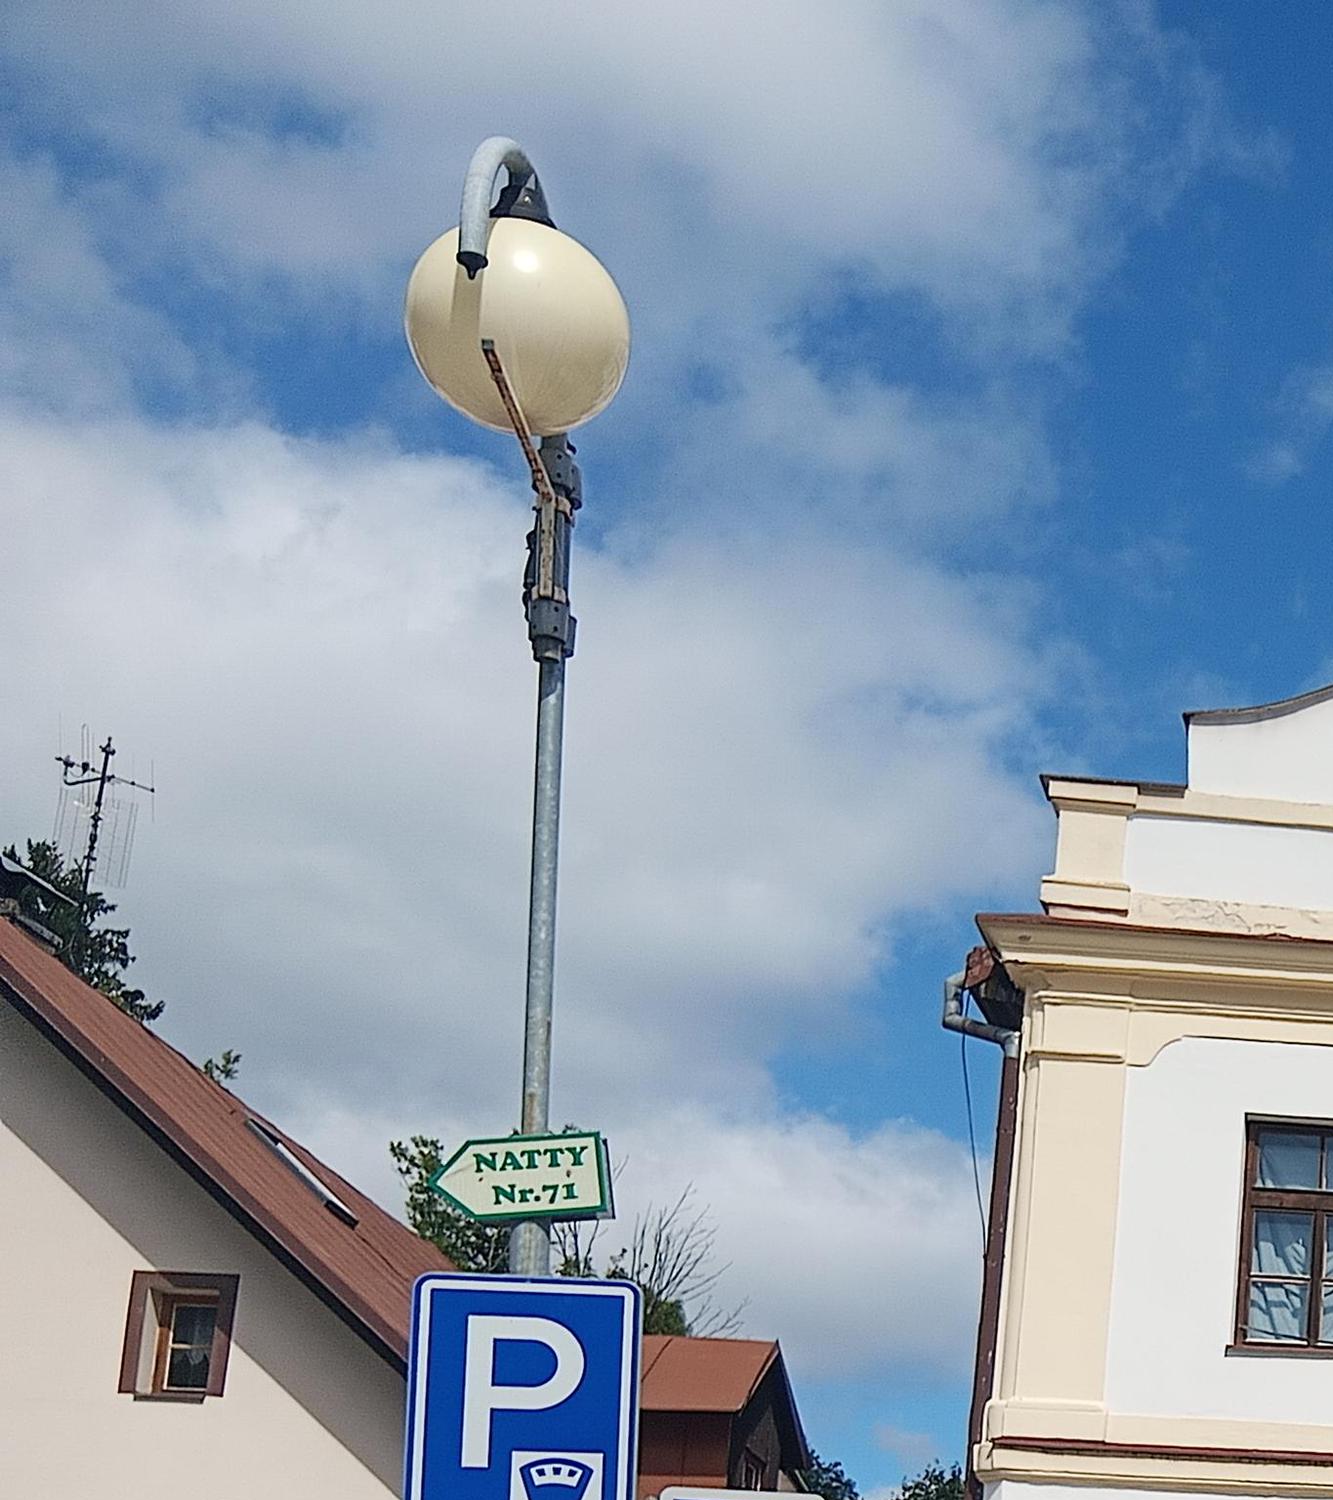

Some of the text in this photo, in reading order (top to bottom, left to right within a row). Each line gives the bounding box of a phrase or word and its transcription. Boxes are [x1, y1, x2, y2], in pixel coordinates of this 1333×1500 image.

[473, 1146, 588, 1173] NATTY
[492, 1183, 578, 1206] Nr.71
[461, 1314, 585, 1468] P
